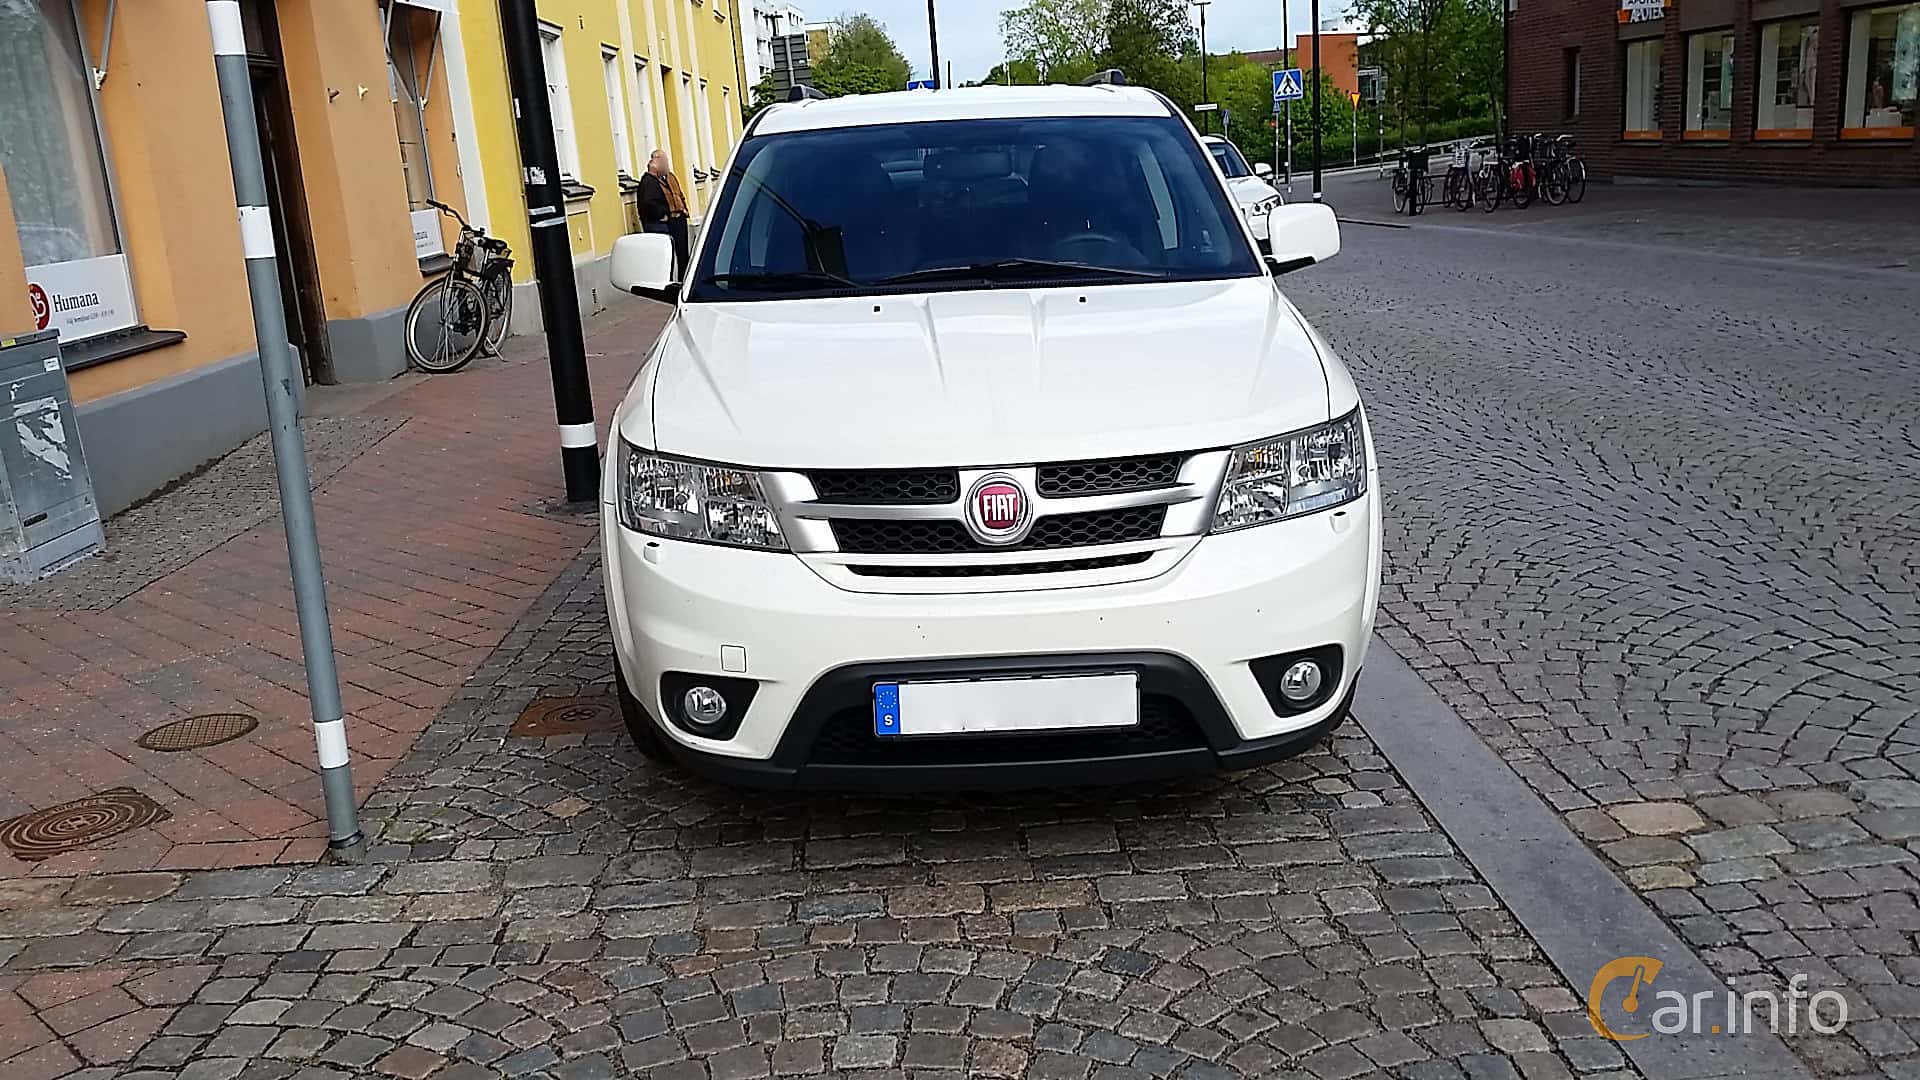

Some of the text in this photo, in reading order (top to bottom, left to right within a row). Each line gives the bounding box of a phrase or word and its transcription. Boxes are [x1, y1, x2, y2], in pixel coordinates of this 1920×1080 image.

[52, 292, 99, 312] Humana
[983, 494, 1016, 521] FIAT
[884, 714, 893, 726] S
